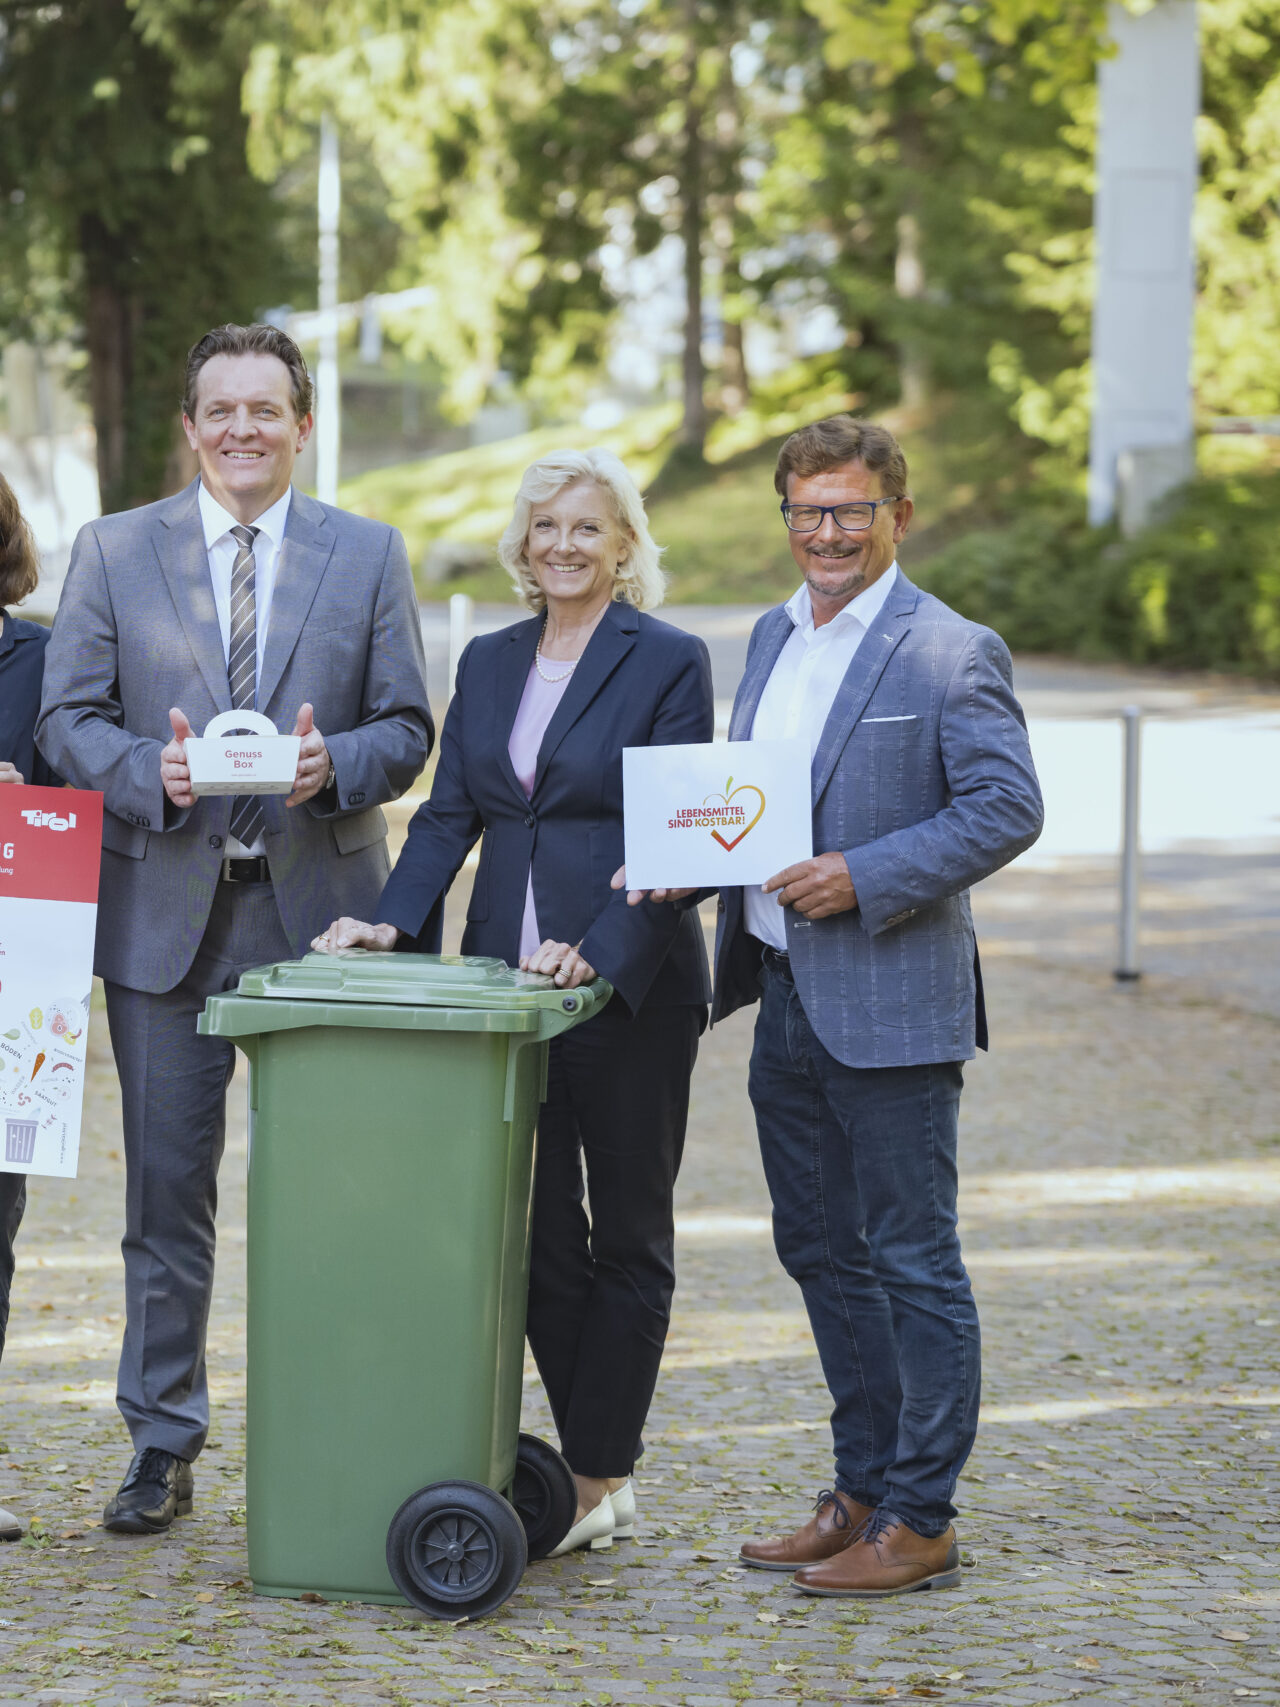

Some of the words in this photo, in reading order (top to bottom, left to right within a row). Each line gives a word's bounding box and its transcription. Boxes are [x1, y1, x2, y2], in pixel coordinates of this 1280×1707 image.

[225, 750, 262, 758] Genuss
[234, 760, 253, 768] Box
[677, 807, 745, 818] LEBENSMITTEL
[21, 810, 77, 832] Tirol
[668, 819, 692, 828] SIND
[695, 816, 745, 827] KOSTBAR!
[0, 1042, 23, 1060] BODEN
